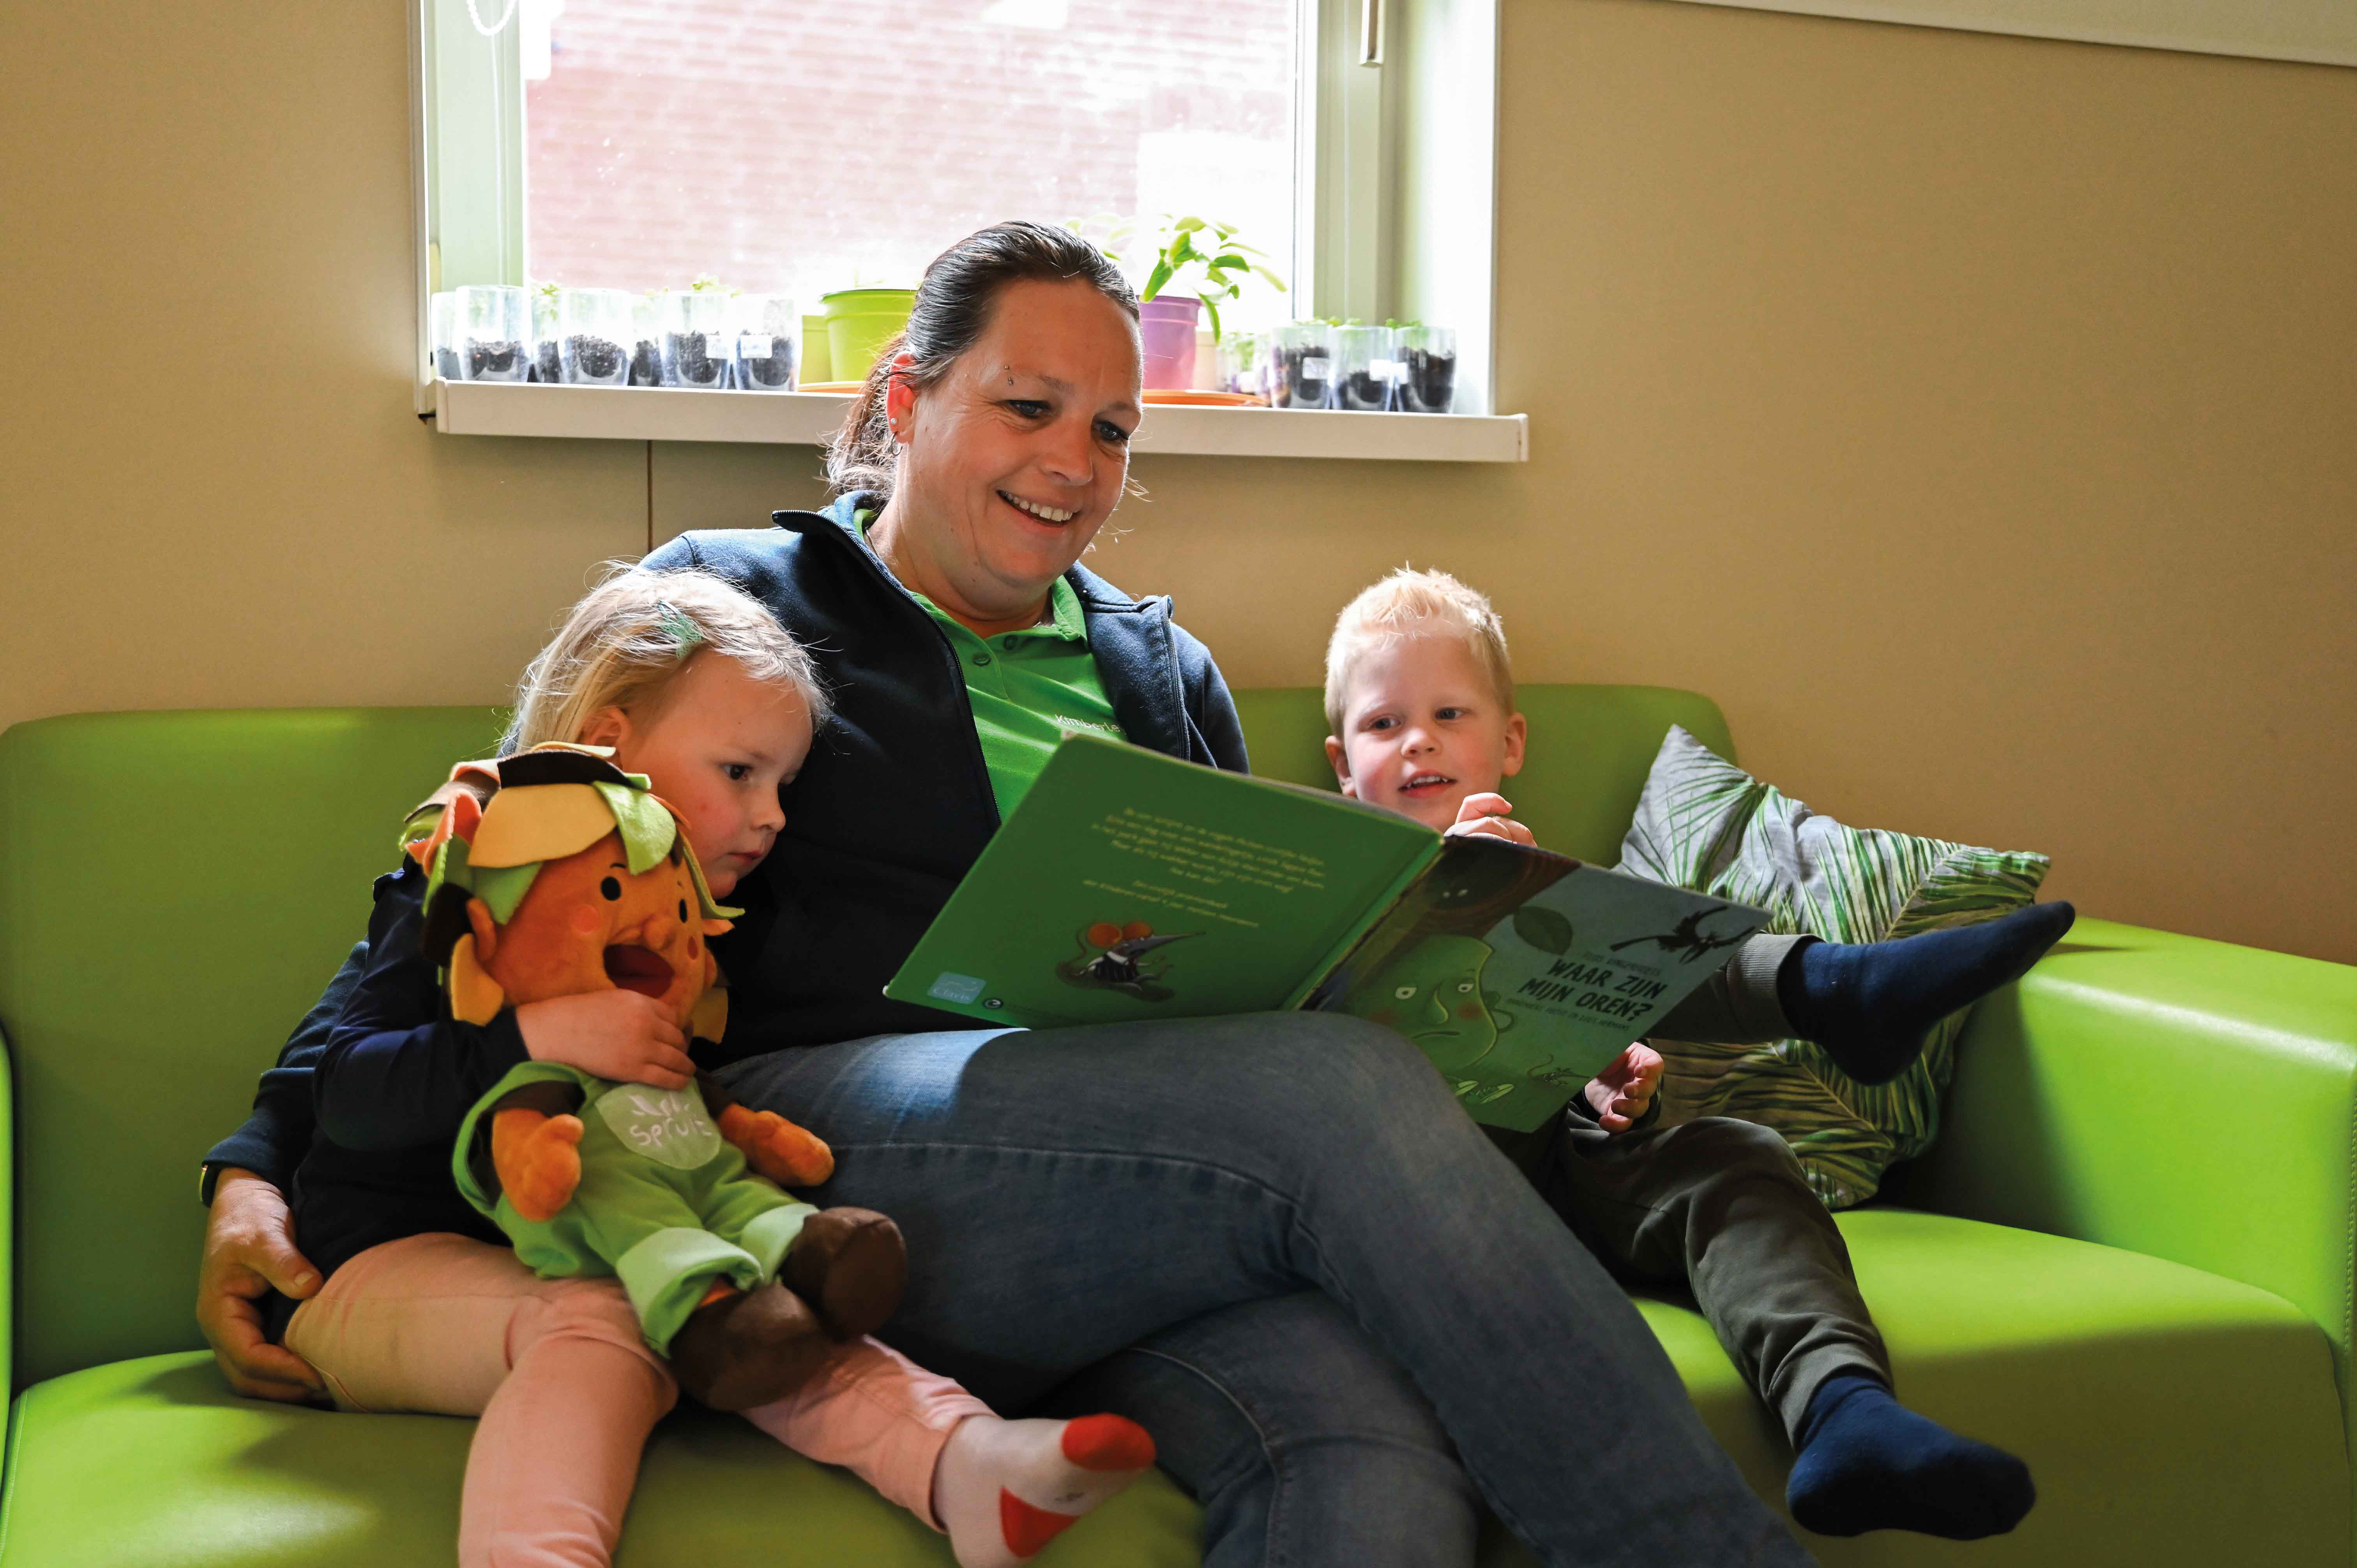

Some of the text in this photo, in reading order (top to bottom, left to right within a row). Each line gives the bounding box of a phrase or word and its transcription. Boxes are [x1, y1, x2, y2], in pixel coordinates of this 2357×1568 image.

[1517, 977, 1575, 1002] MIJN
[1576, 992, 1653, 1021] OREN?
[1547, 959, 1613, 987] WAAR
[1613, 975, 1668, 999] ZIJN
